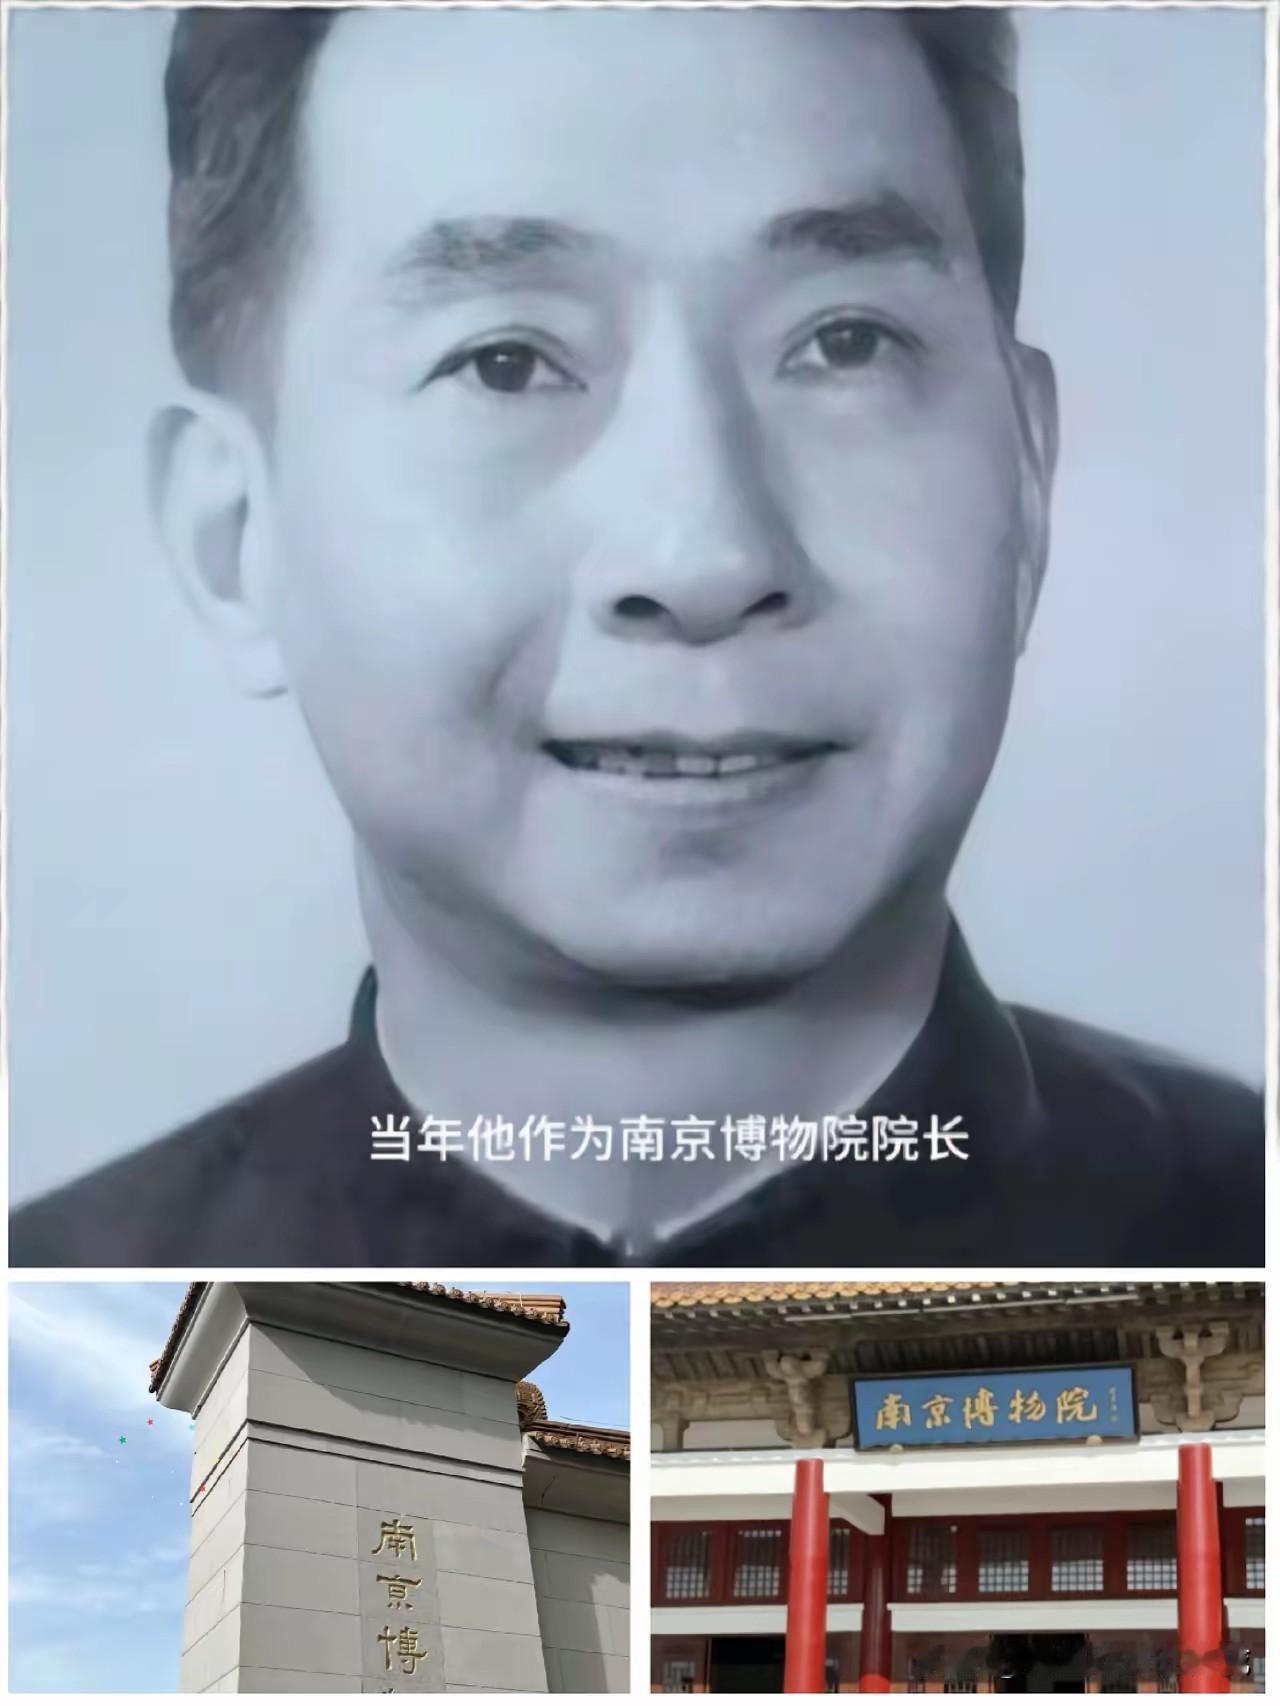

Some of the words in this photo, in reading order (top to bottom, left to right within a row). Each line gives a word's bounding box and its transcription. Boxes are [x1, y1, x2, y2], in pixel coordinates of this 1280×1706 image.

[875, 1387, 1098, 1431] 南京博物院
[371, 1519, 428, 1694] 南京博
